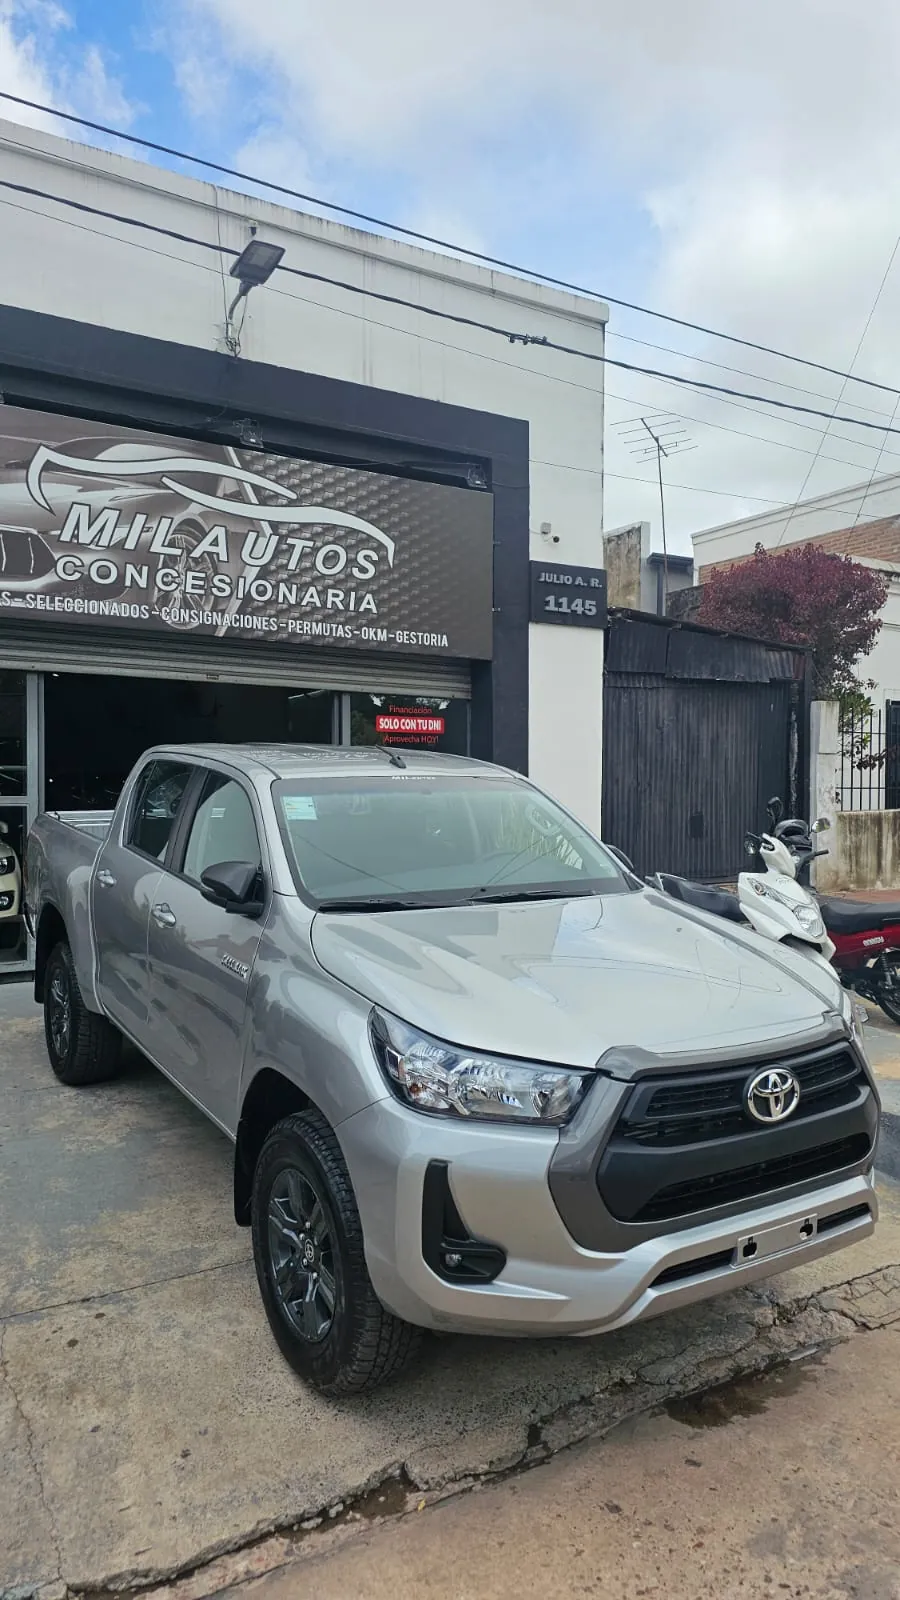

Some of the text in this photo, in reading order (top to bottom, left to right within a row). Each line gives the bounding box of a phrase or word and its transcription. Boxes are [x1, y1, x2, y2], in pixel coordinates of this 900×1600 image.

[59, 502, 379, 581] MILAUTOS
[55, 555, 379, 614] CONCESIONARIA
[538, 572, 603, 588] JULIO A. R.
[544, 595, 598, 616] 1145
[379, 718, 441, 731] SOLO CON TU DNI
